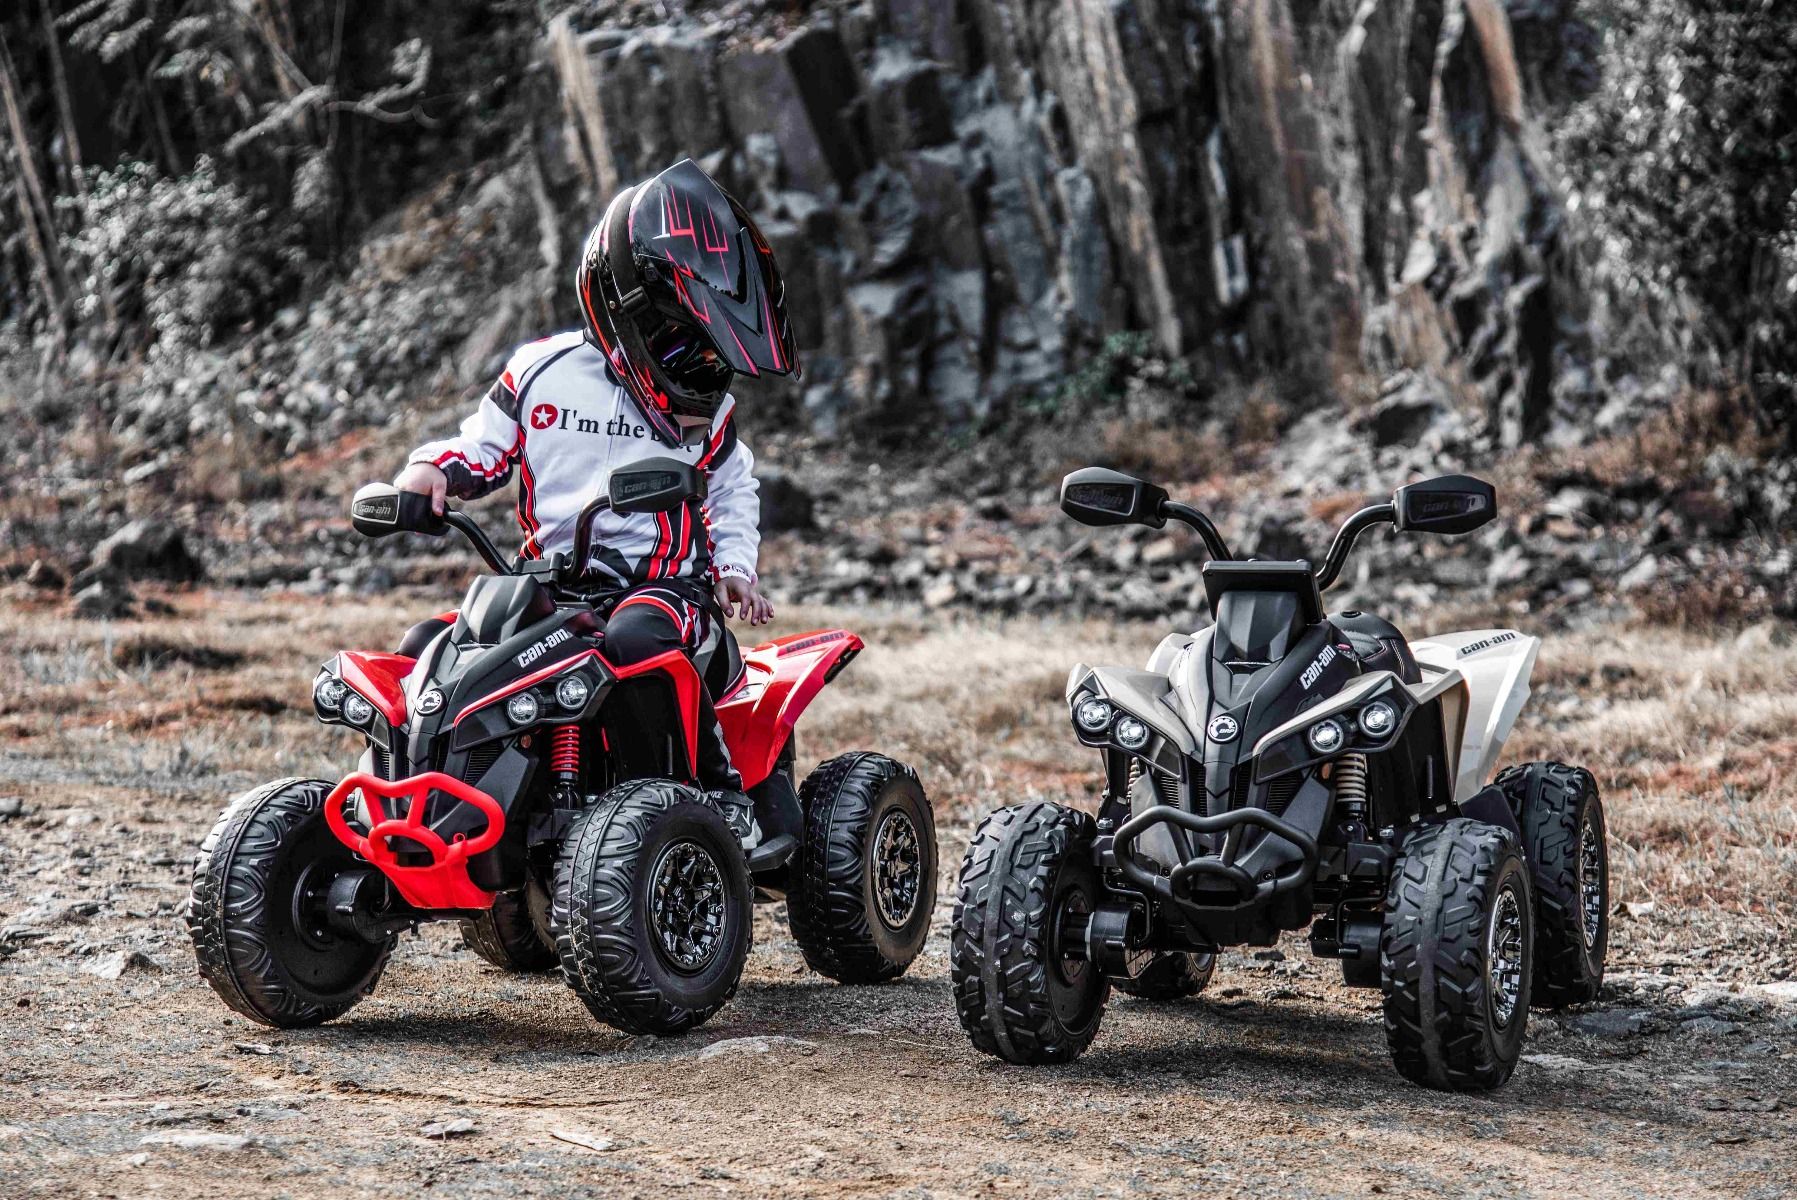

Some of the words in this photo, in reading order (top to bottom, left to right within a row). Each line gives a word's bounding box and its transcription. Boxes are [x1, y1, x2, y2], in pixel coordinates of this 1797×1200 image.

[558, 408, 599, 434] I'm
[606, 414, 645, 438] the
[517, 627, 568, 669] can-am
[1461, 632, 1516, 655] can-am
[1300, 644, 1337, 690] can-am
